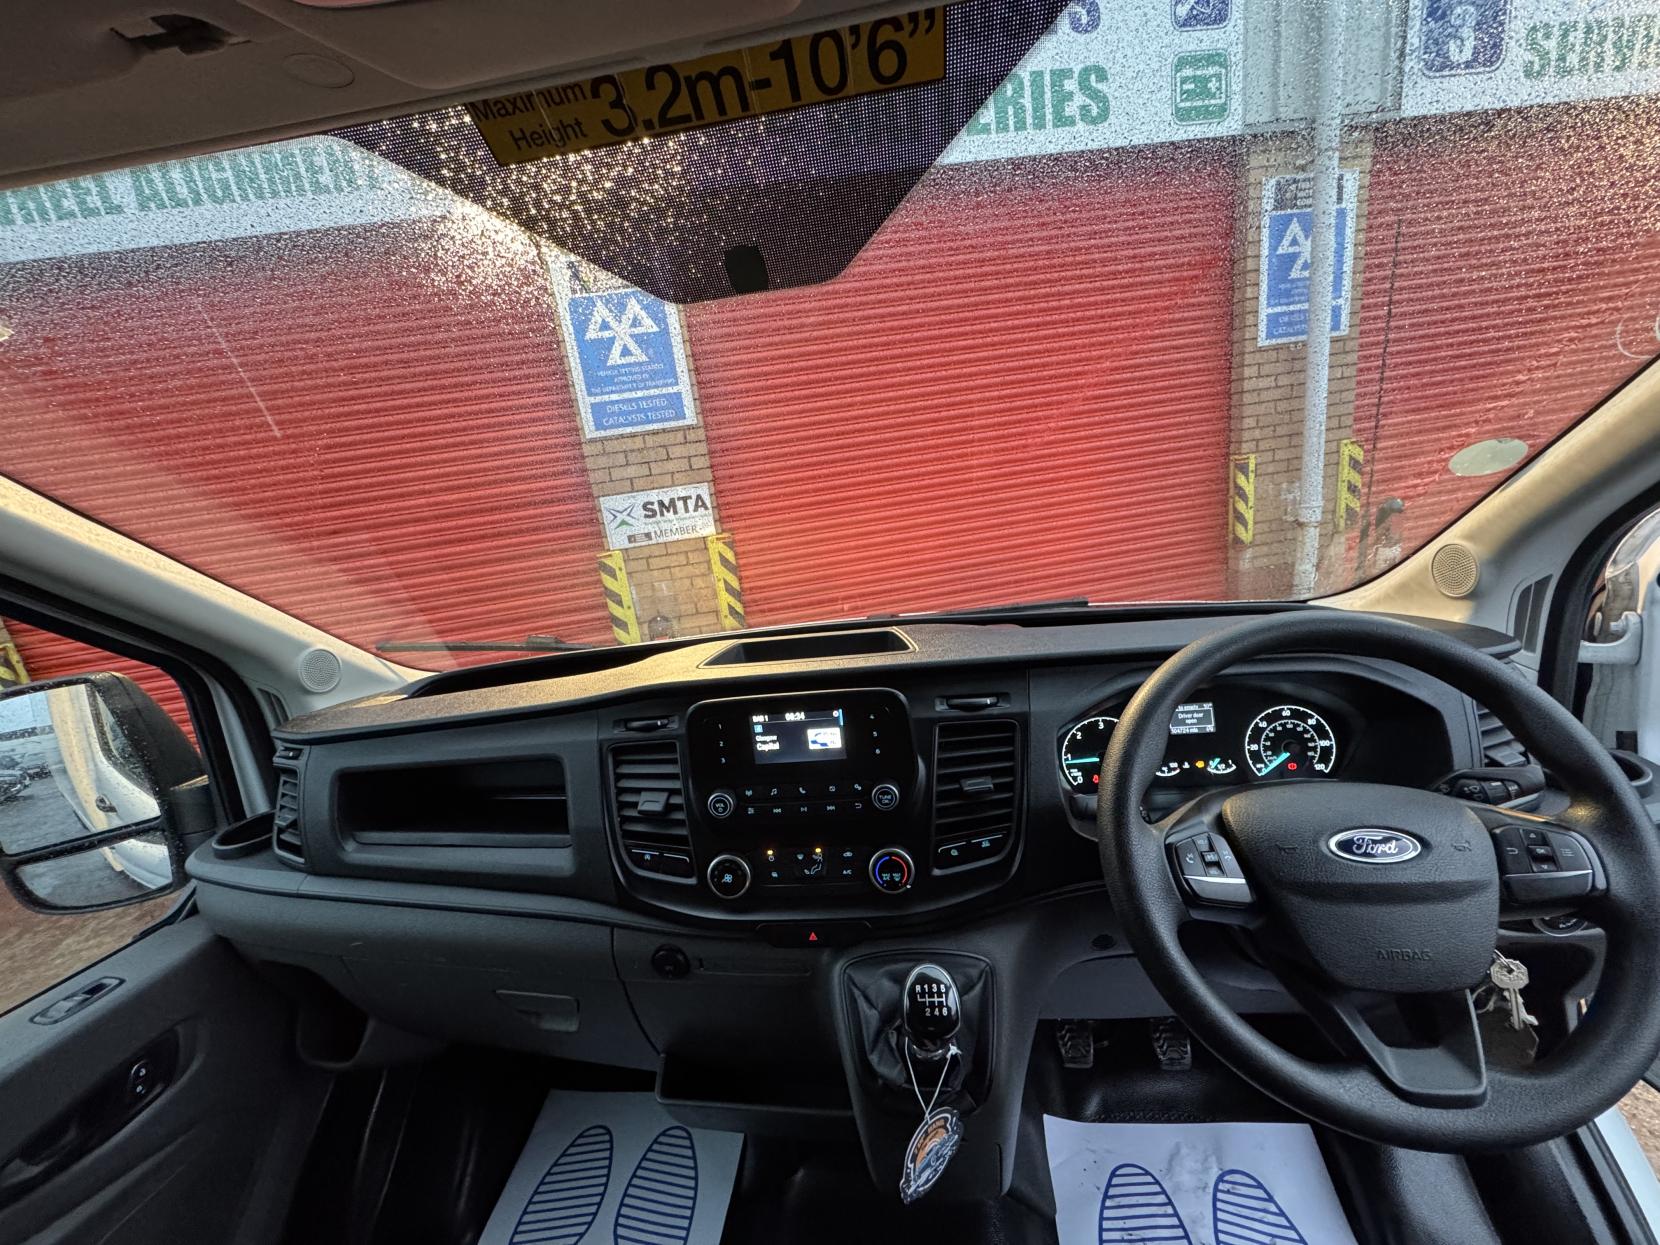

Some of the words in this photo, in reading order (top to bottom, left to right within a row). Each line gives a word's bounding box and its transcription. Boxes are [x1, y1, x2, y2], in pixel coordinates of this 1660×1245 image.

[509, 116, 587, 152] Height
[606, 403, 637, 413] DIESELS
[639, 398, 667, 409] TESTED
[603, 414, 646, 426] CATALYSTS
[648, 409, 676, 420] TESTED
[642, 494, 709, 518] SMTA
[654, 525, 699, 541] MEMBER
[1098, 721, 1104, 729] 3
[1076, 731, 1082, 739] 2
[1352, 836, 1399, 854] Ford
[1377, 949, 1432, 961] AIRBAG
[915, 984, 921, 993] R
[923, 984, 928, 992] 1
[932, 983, 937, 992] 3
[940, 984, 946, 992] 5
[925, 1007, 931, 1016] 2
[934, 1007, 939, 1016] 4
[942, 1007, 948, 1016] 6
